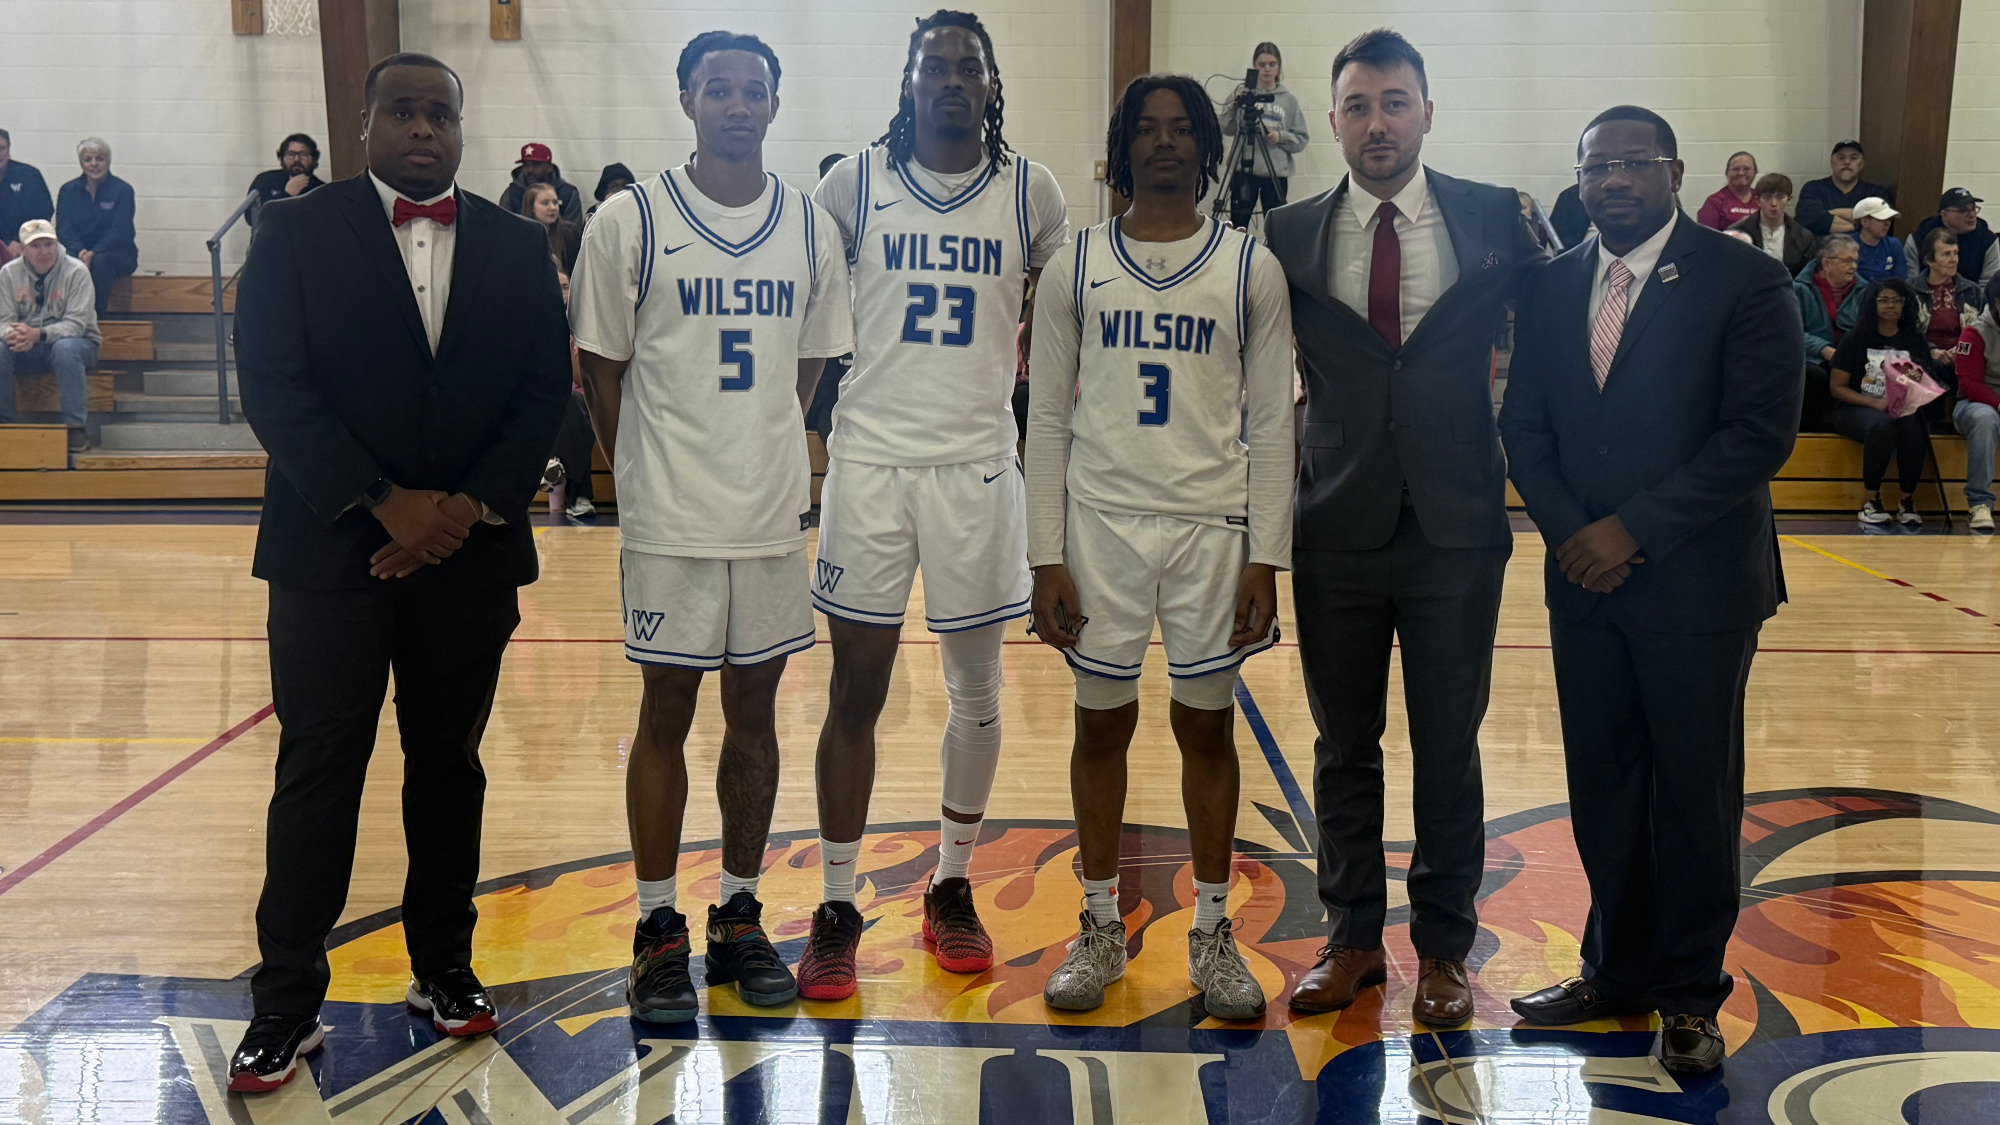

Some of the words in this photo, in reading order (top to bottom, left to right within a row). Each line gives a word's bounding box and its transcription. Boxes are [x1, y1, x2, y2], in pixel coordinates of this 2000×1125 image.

[883, 233, 1002, 276] WILSON
[677, 278, 795, 319] WILSON
[900, 281, 977, 347] 23
[1100, 310, 1216, 355] WILSON
[719, 328, 755, 393] 5
[1137, 362, 1172, 427] 3
[816, 558, 845, 594] W
[632, 609, 665, 641] W
